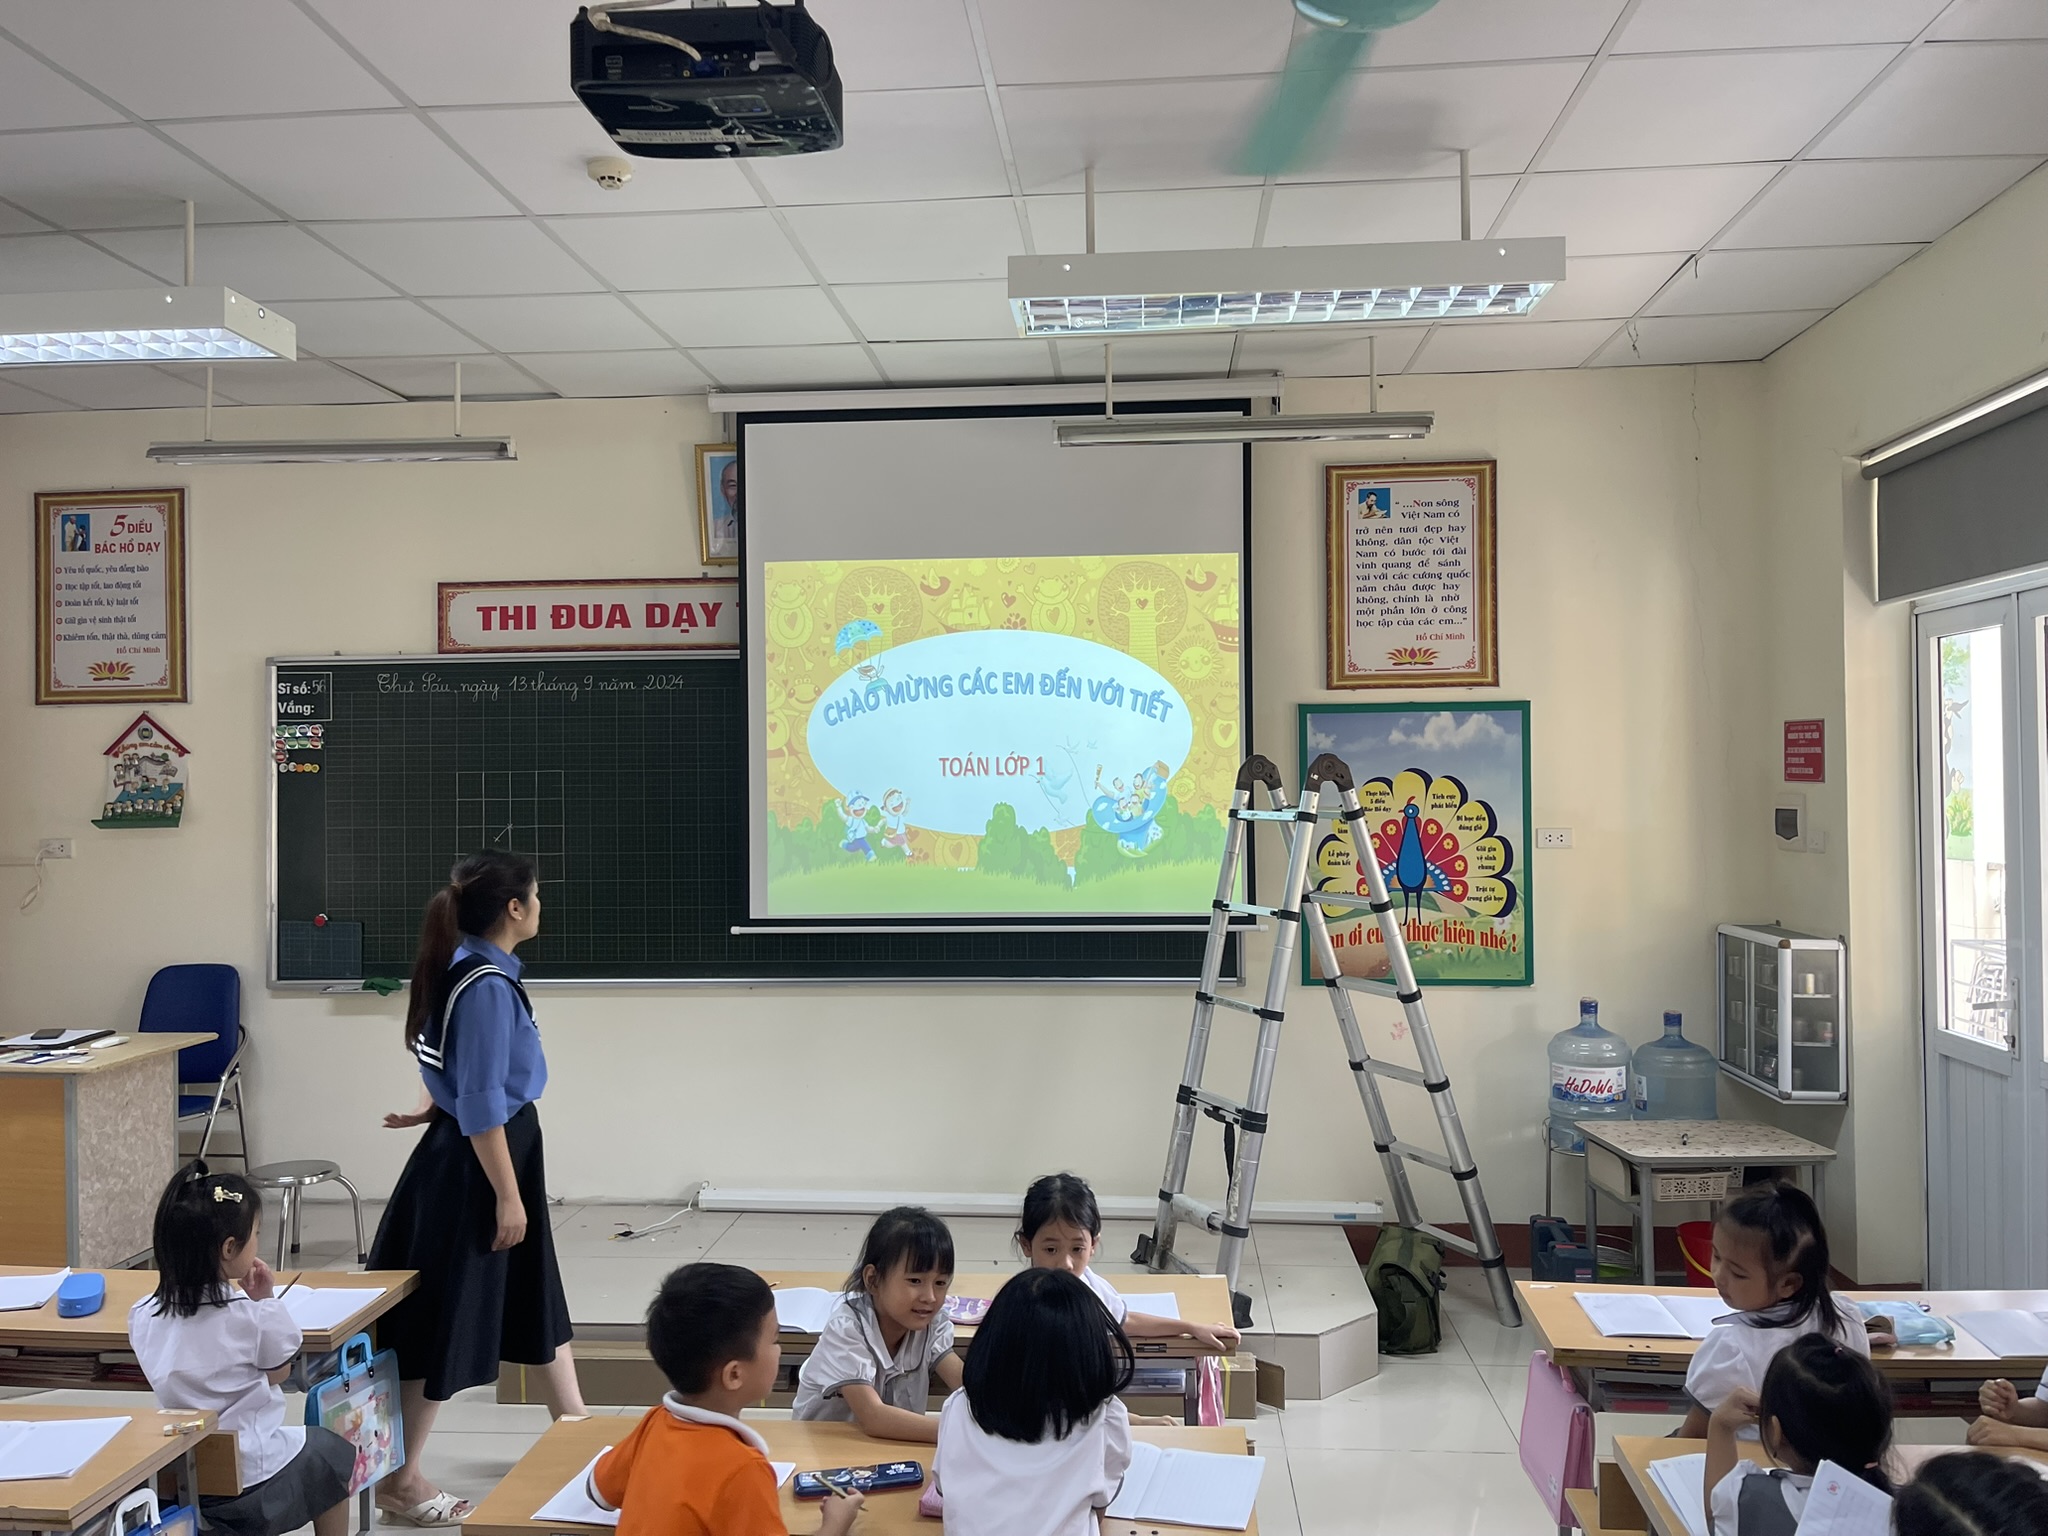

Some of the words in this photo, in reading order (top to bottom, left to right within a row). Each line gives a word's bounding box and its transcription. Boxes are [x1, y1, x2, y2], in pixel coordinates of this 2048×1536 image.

[1436, 499, 1459, 507] sông
[1401, 511, 1420, 520] Việt
[1448, 510, 1460, 518] có
[110, 515, 128, 536] 5
[127, 518, 152, 534] ĐIỀU
[1356, 527, 1369, 535] trở
[1375, 526, 1393, 534] nên
[1424, 525, 1442, 534] đẹp
[1448, 524, 1466, 533] hay
[95, 541, 116, 553] BÁC
[120, 538, 134, 553] HỒ
[138, 542, 161, 555] DẠY
[1394, 537, 1412, 545] dân
[1419, 536, 1433, 546] tộc
[1440, 536, 1459, 544] Việt
[1356, 550, 1377, 558] Nam
[1384, 549, 1396, 557] có
[1402, 548, 1426, 556] bước
[1433, 547, 1445, 555] tới
[1451, 547, 1466, 555] đài
[106, 566, 118, 574] yêu
[1356, 561, 1376, 569] vinh
[1382, 561, 1411, 570] quang
[1437, 559, 1461, 567] sánh
[1356, 573, 1370, 581] vai
[1392, 572, 1409, 580] các
[1446, 569, 1471, 579] quốc
[1356, 585, 1377, 593] năm
[1383, 584, 1406, 592] châu
[1412, 583, 1436, 592] được
[1443, 582, 1460, 591] hay
[1393, 595, 1419, 603] chính
[1441, 593, 1460, 602] nhờ
[1356, 607, 1375, 616] một
[1410, 606, 1426, 614] lớn
[1431, 605, 1438, 614] ở
[1443, 605, 1468, 614] công
[477, 605, 537, 631] THI
[550, 603, 632, 630] ĐUA
[645, 602, 723, 634] DẠY
[1356, 619, 1374, 628] học
[1378, 618, 1393, 628] tập
[1397, 618, 1414, 626] của
[1418, 618, 1435, 626] các
[1416, 632, 1427, 641] Hồ
[1446, 632, 1465, 640] Minh
[116, 646, 126, 654] Hồ
[278, 683, 291, 694] Sĩ
[293, 681, 311, 694] số:
[460, 678, 500, 702] ngày
[508, 674, 528, 692] 13
[530, 670, 579, 701] tháng
[583, 674, 593, 691] 9
[599, 678, 636, 691] năm
[642, 674, 684, 691] 2024
[823, 689, 882, 728] CHÀO
[884, 671, 953, 707] MỪNG
[958, 666, 999, 696] CÁC
[1002, 671, 1035, 696] EM
[1039, 667, 1083, 700] ĐẾN
[1087, 675, 1128, 709] VỚI
[1129, 686, 1174, 724] TIẾT
[278, 700, 315, 716] Vắng:
[939, 751, 990, 777] TOÁN
[994, 750, 1031, 776] LỚP
[1035, 755, 1046, 776] 1
[1406, 918, 1439, 950] thực
[1443, 919, 1475, 953] hiện
[1479, 927, 1507, 951] nhé
[1565, 1076, 1613, 1095] HaDoWa
